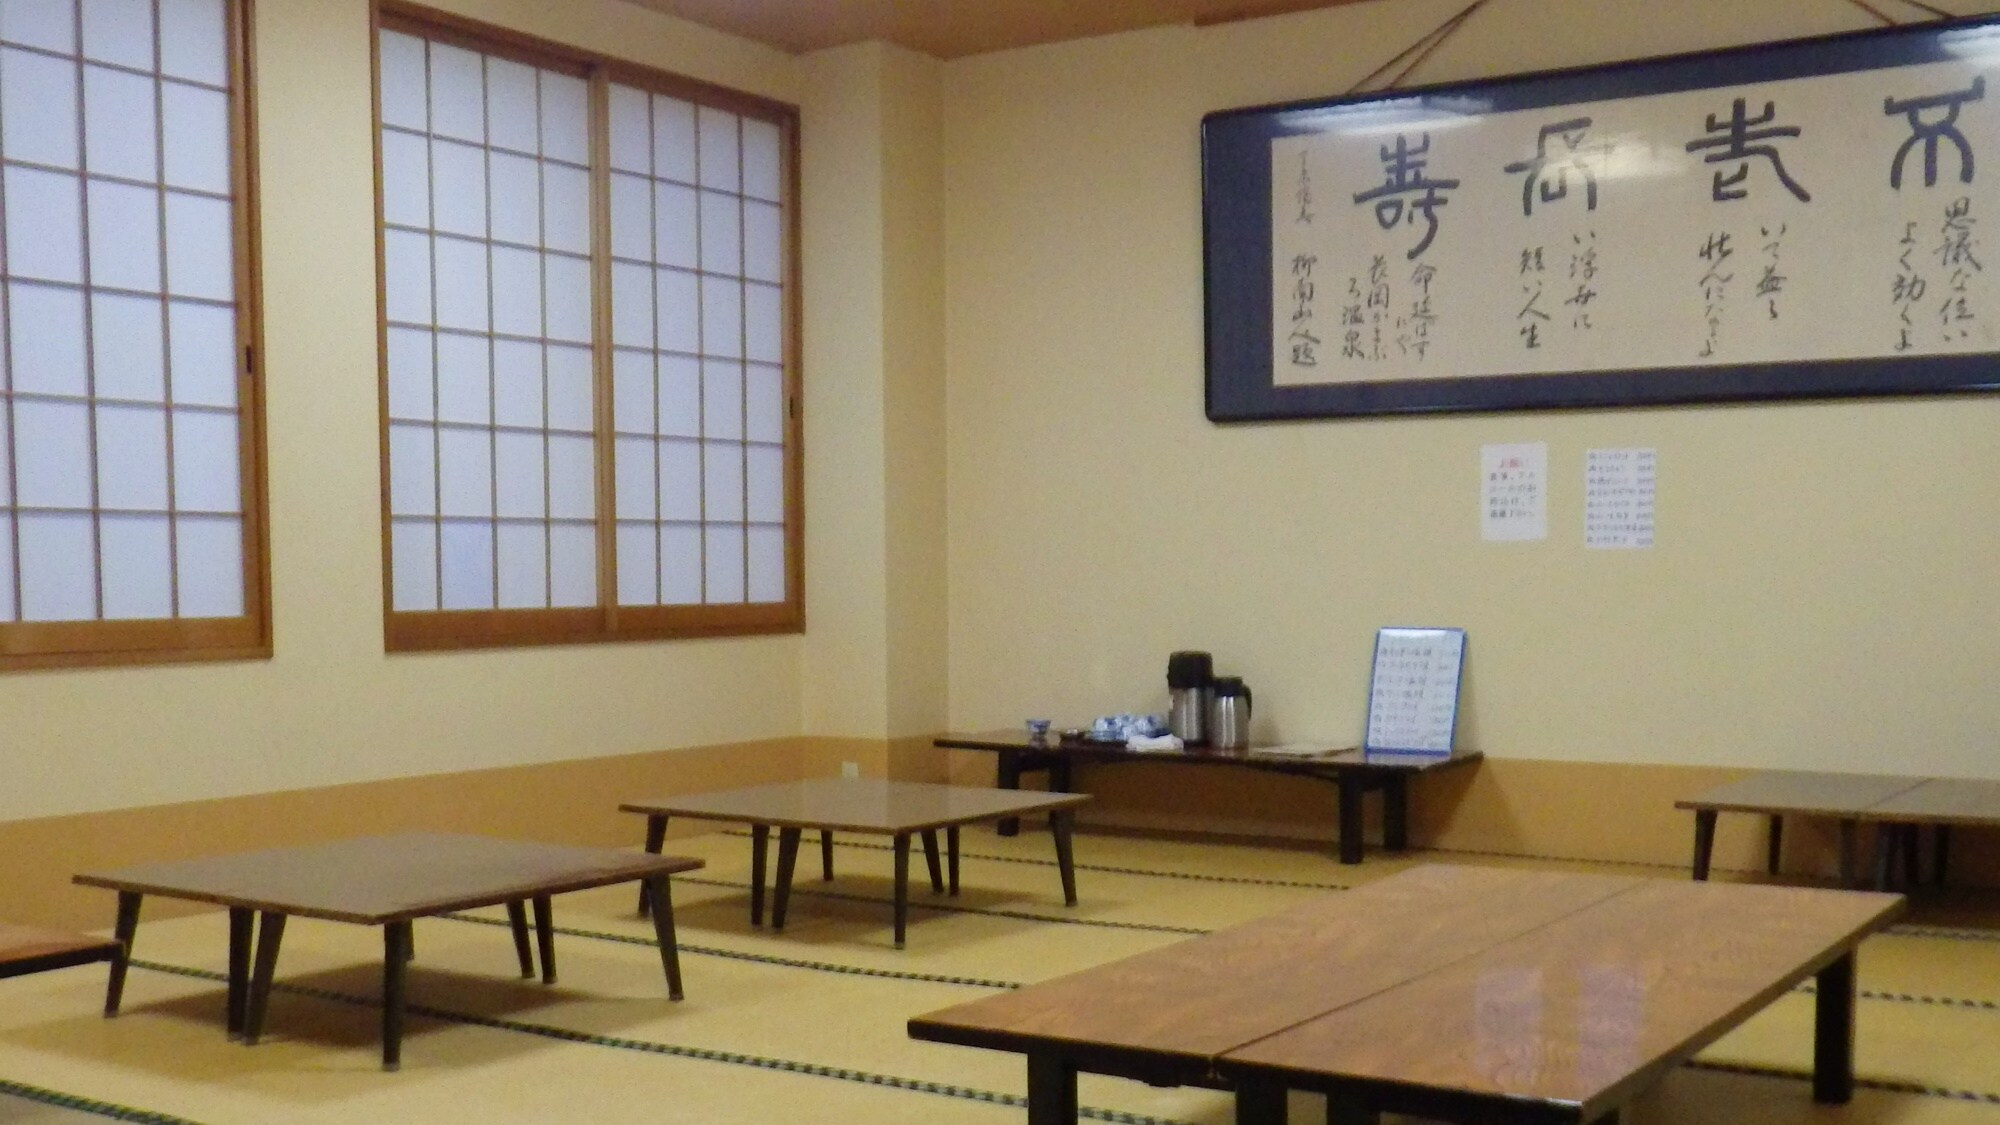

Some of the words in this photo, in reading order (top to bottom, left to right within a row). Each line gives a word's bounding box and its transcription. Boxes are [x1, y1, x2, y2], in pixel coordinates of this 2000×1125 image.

[1884, 75, 1986, 190] 不
[1517, 246, 1551, 349] 短い人生
